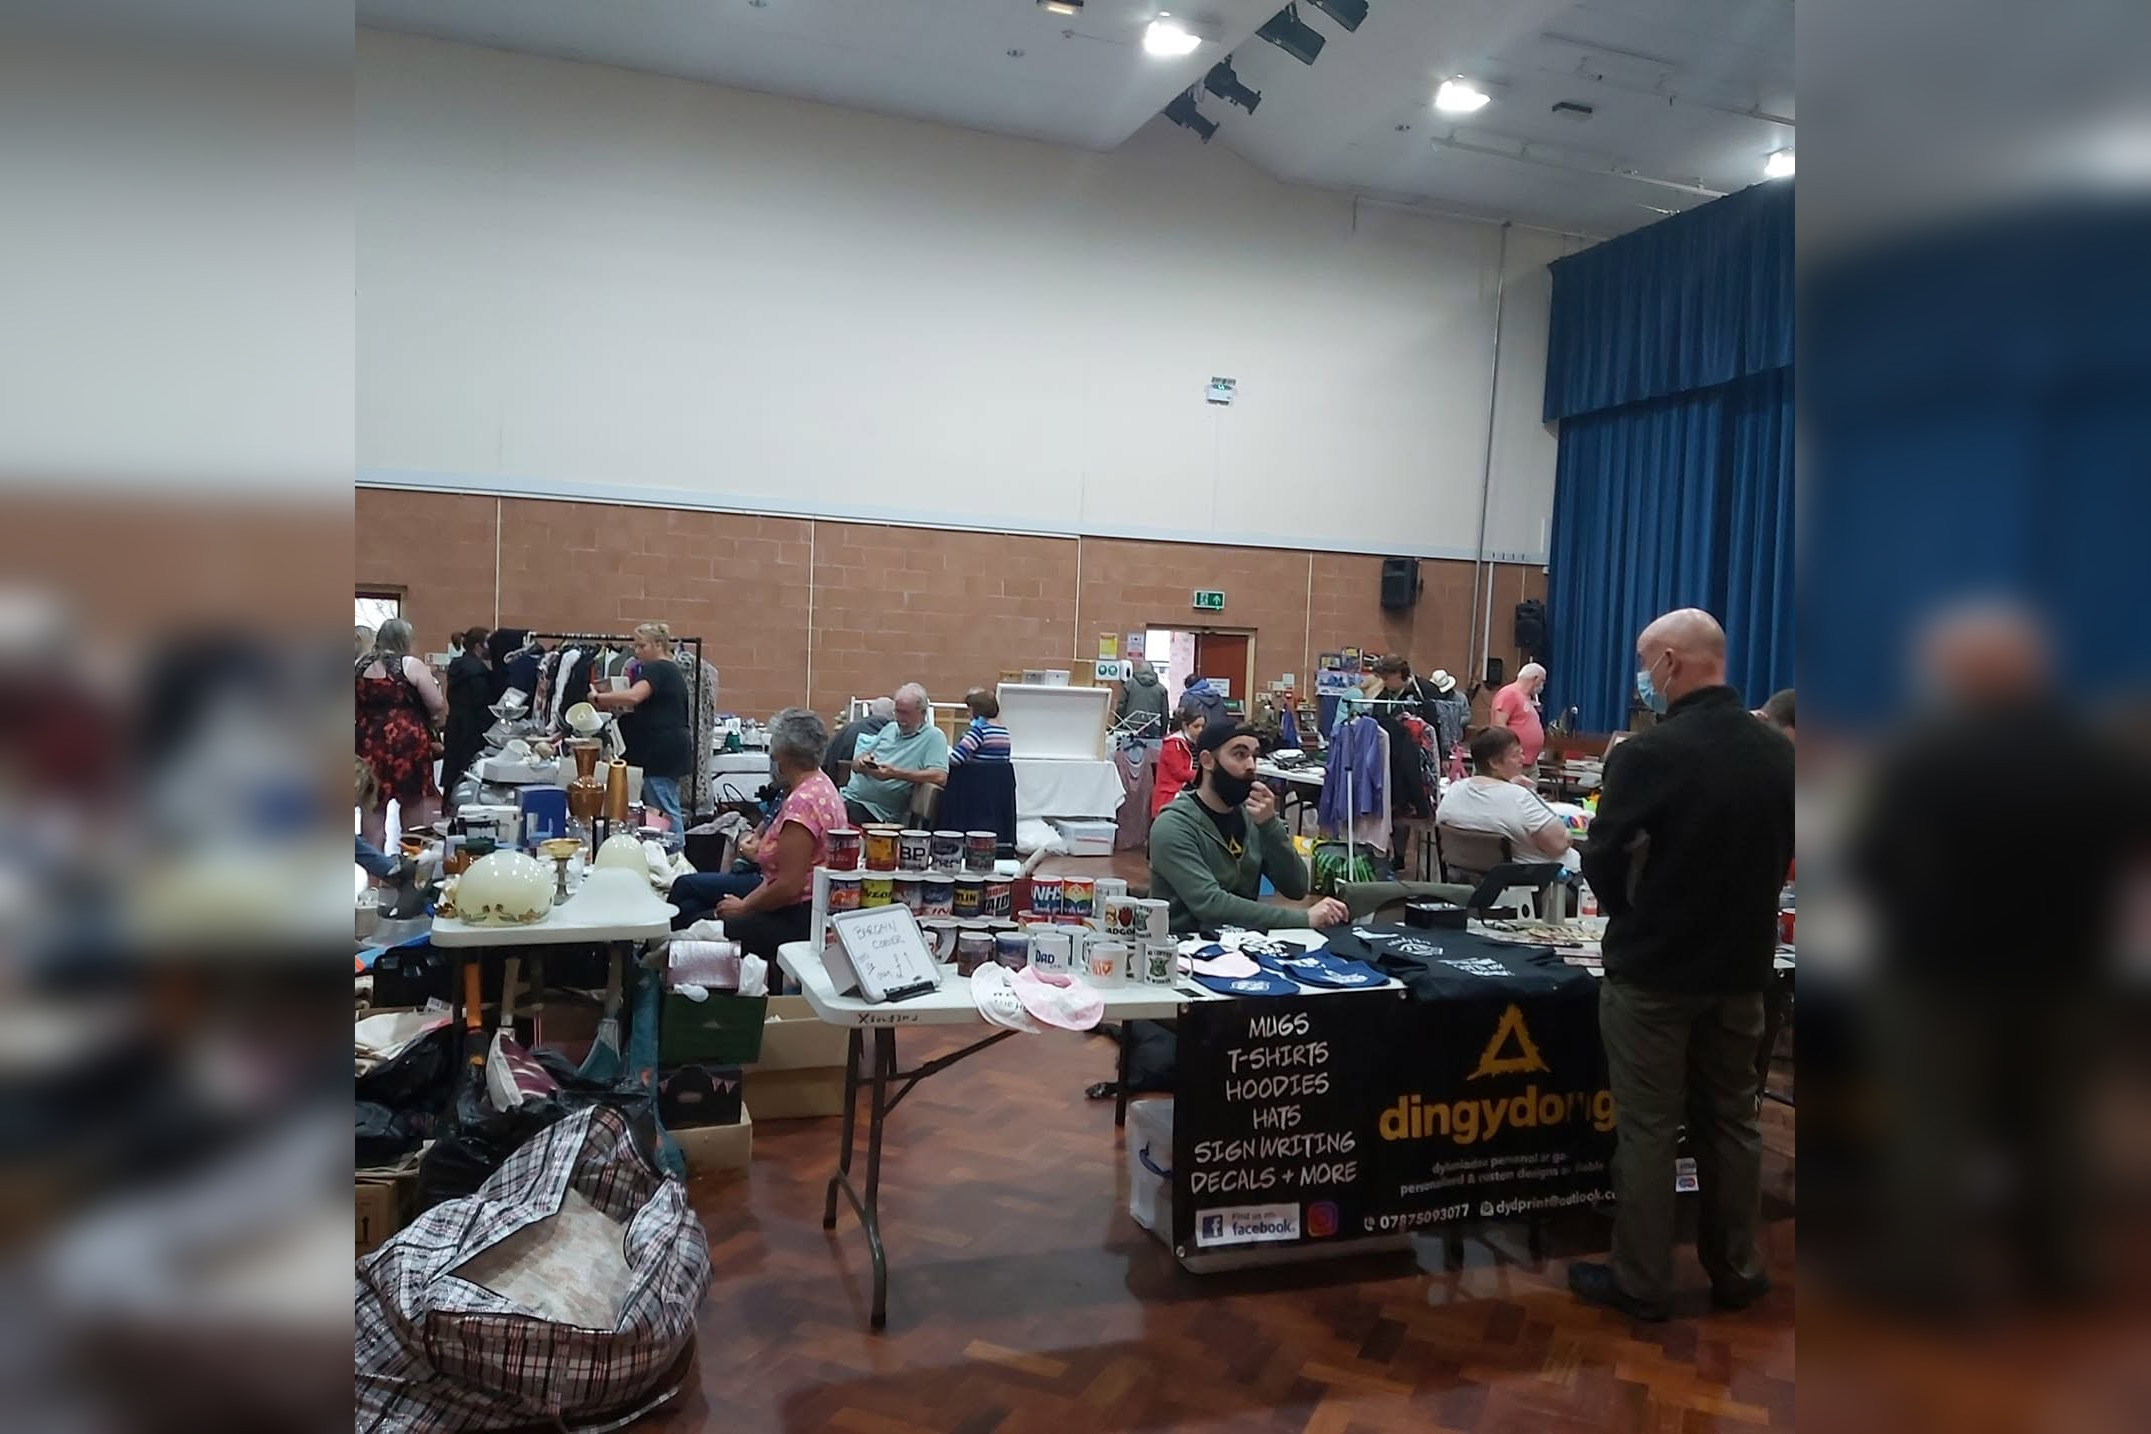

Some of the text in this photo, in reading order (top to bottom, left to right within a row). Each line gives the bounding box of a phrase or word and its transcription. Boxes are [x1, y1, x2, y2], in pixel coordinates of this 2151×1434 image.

[1033, 885, 1061, 901] NHS
[1035, 950, 1055, 965] DAD
[1249, 1012, 1309, 1039] MUGS
[1227, 1041, 1330, 1073] T-SHIRTS
[1226, 1072, 1330, 1101] HOODIES
[1252, 1104, 1301, 1131] HATS
[1194, 1131, 1356, 1164] SIGN WRITING
[1191, 1160, 1357, 1194] DECALS + MORE
[1232, 1212, 1250, 1220] Find
[1232, 1219, 1292, 1237] facebook
